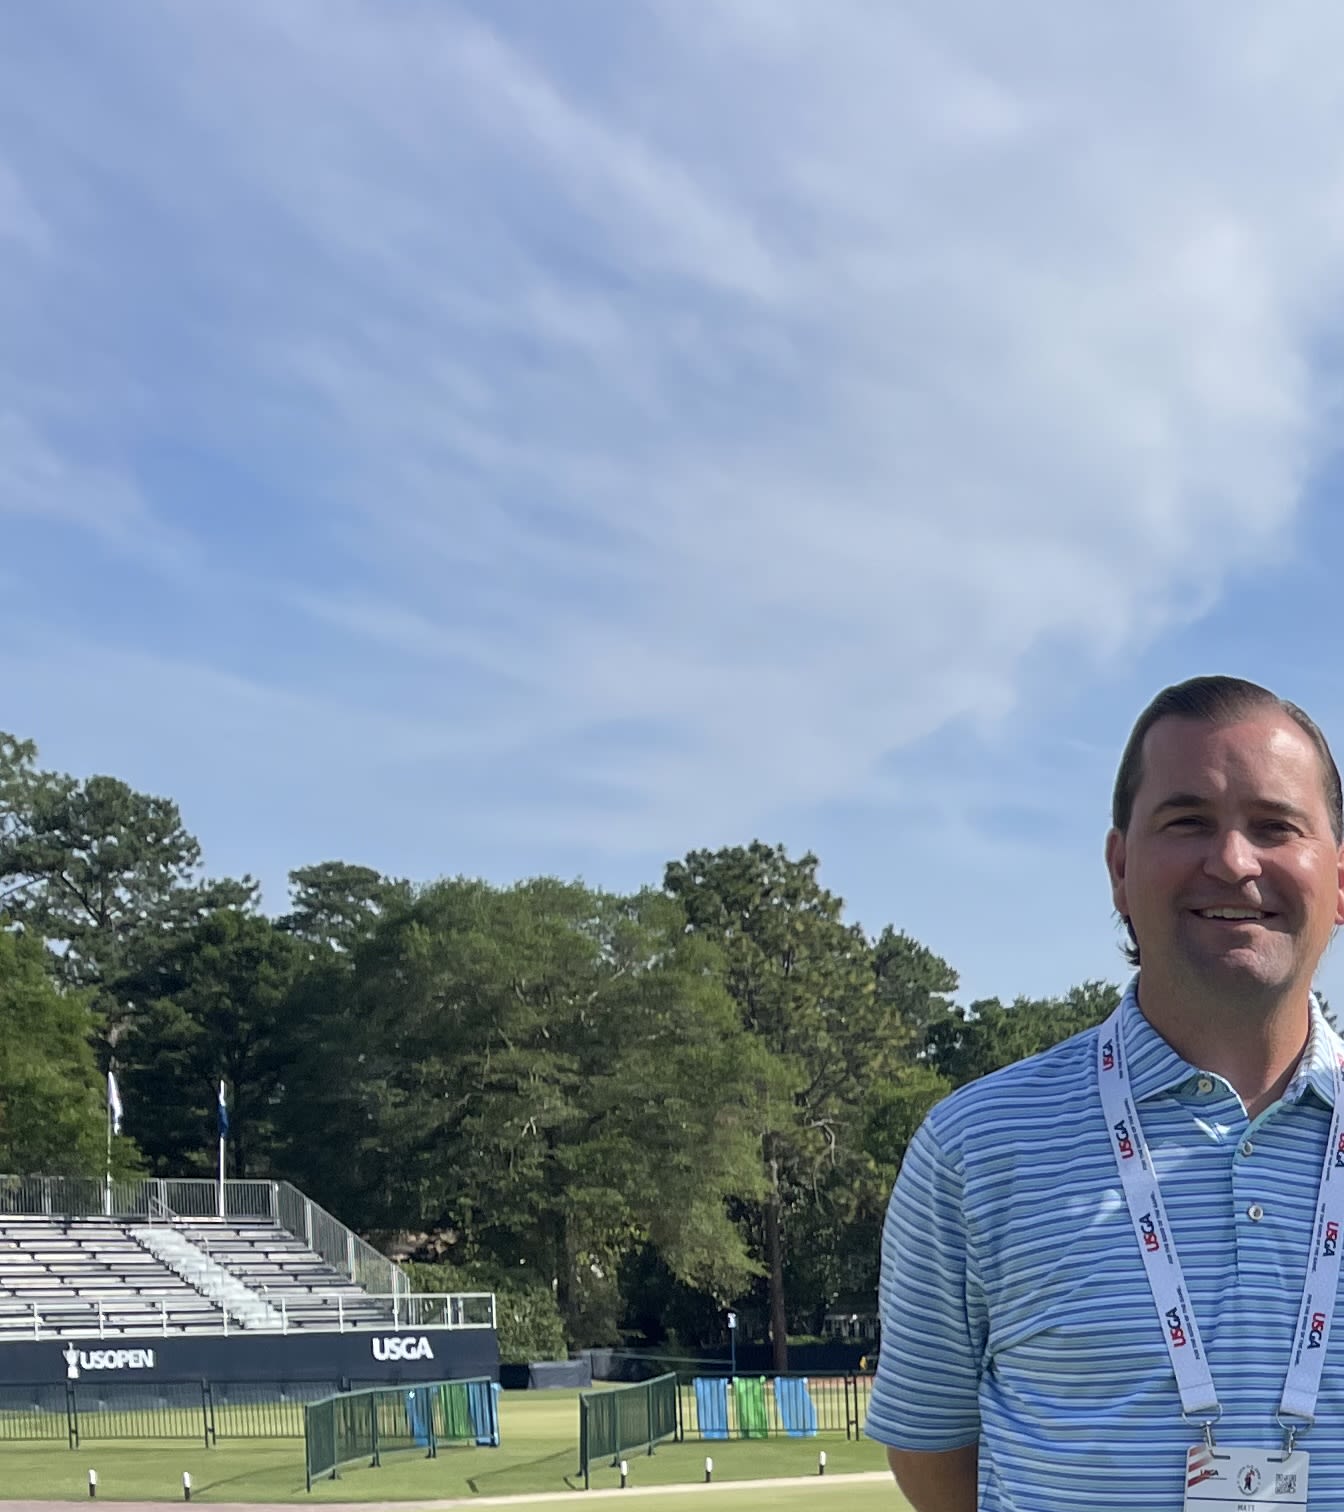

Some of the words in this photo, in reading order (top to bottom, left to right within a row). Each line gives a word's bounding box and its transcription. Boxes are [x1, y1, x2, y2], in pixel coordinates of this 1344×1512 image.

[1103, 1039, 1114, 1071] USGA
[1114, 1120, 1134, 1159] USGA
[1139, 1213, 1159, 1252] USGA
[1323, 1222, 1339, 1256] USGA
[1166, 1307, 1186, 1347] USGA
[1307, 1313, 1325, 1349] USGA
[80, 1349, 154, 1370] USOPEN
[372, 1336, 434, 1361] USGA
